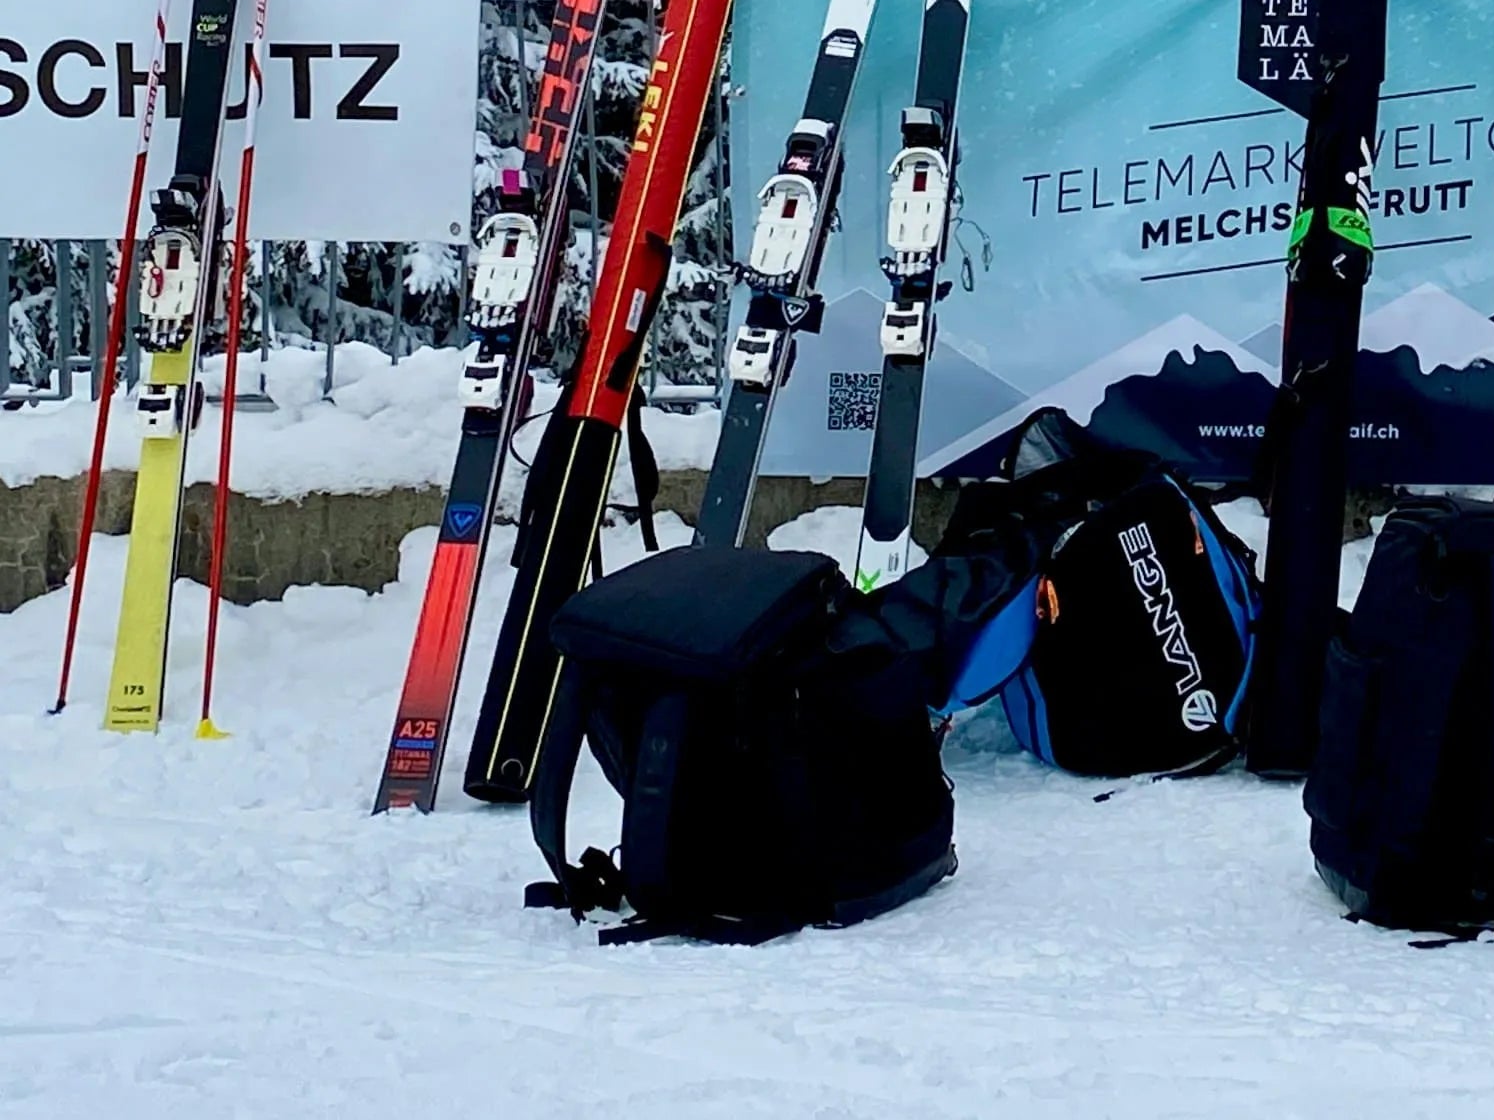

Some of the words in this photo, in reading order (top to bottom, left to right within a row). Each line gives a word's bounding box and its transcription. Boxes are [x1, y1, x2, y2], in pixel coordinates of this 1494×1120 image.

[197, 23, 219, 32] CUP
[632, 60, 669, 152] LEKI
[1022, 141, 1306, 217] TELEMARK
[1117, 521, 1202, 696] LANGE
[399, 720, 438, 739] A25
